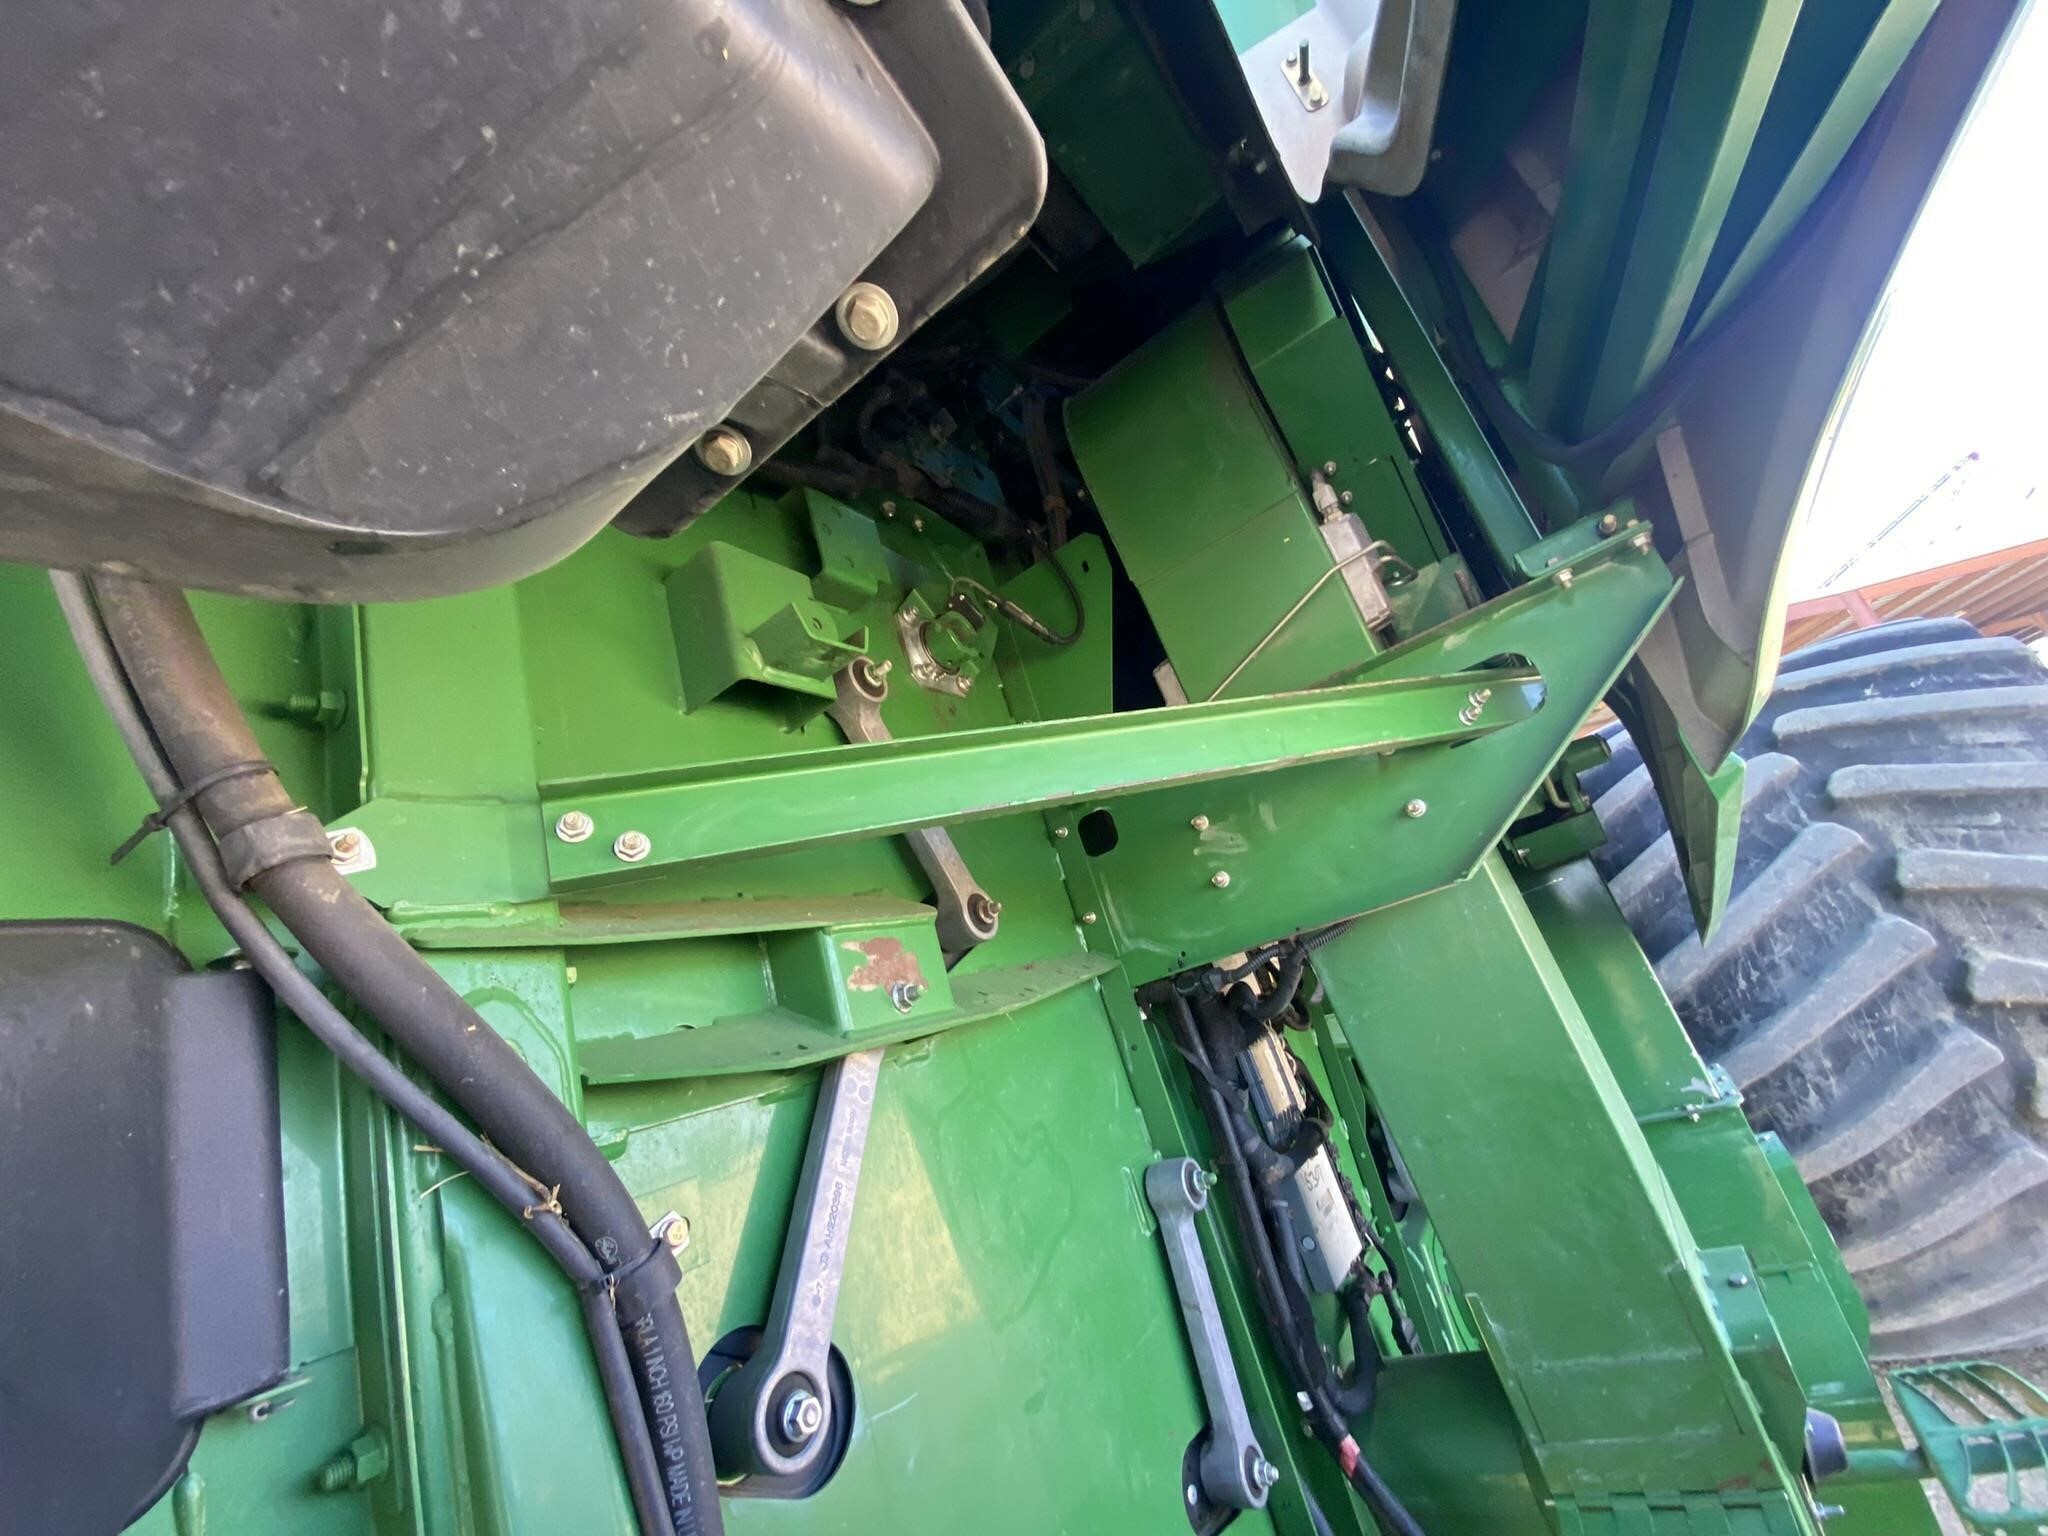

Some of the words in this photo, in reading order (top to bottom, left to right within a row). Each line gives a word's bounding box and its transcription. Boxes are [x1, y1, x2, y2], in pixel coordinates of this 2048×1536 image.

[645, 1353, 670, 1390] INCH
[657, 1412, 680, 1439] PSI
[667, 1462, 691, 1507] MADE
